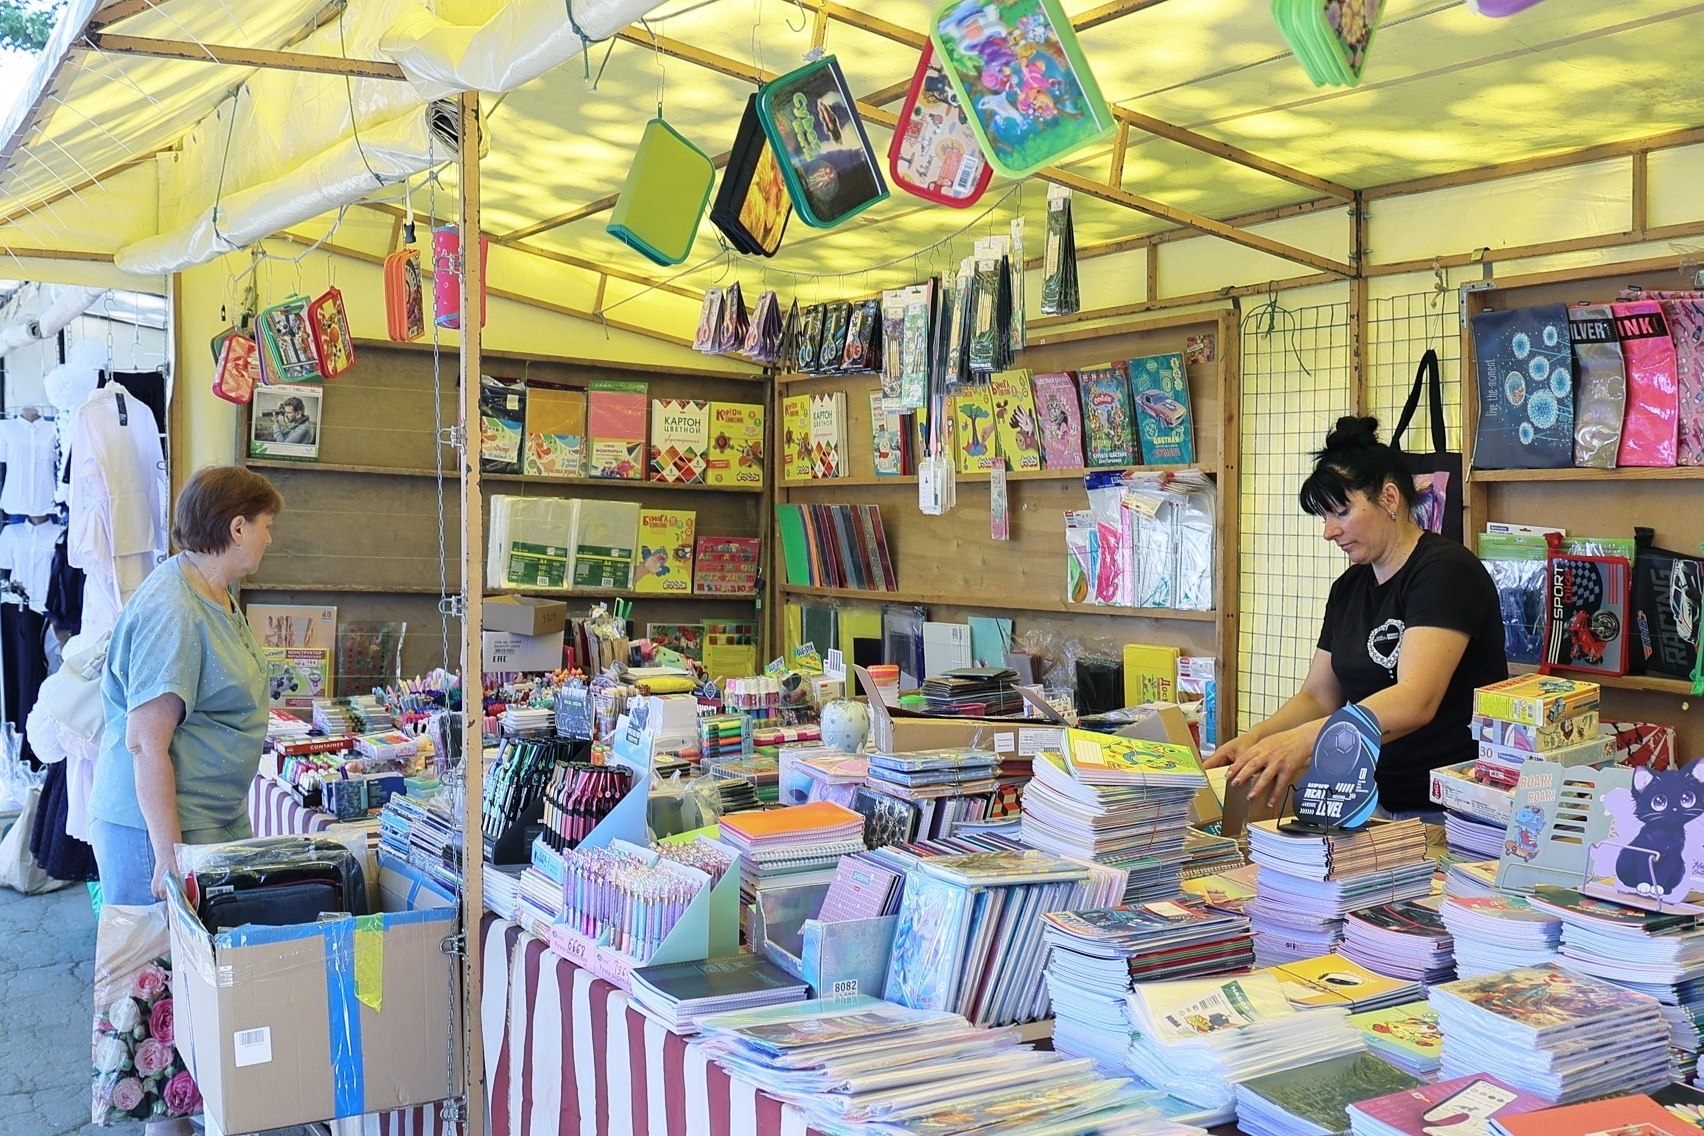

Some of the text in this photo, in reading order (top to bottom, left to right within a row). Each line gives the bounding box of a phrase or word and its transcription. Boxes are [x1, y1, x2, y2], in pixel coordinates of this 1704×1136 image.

[1569, 322, 1606, 340] ILVER
[1616, 317, 1654, 337] INK
[813, 410, 833, 420] КАРТОН
[1485, 403, 1498, 417] live
[664, 416, 701, 427] КАРТОН
[813, 419, 833, 428] ЦВЕТНОЙ
[664, 426, 701, 434] ЦВЕТНОЙ
[1553, 564, 1564, 619] SPORT
[1650, 569, 1688, 665] RACING
[310, 742, 344, 750] CONTAINER
[1480, 746, 1493, 758] 30
[1520, 774, 1553, 789] ROAR!
[1528, 790, 1557, 803] ROAR!
[834, 980, 857, 993] 8082
[1230, 985, 1250, 1010] НАБОР
